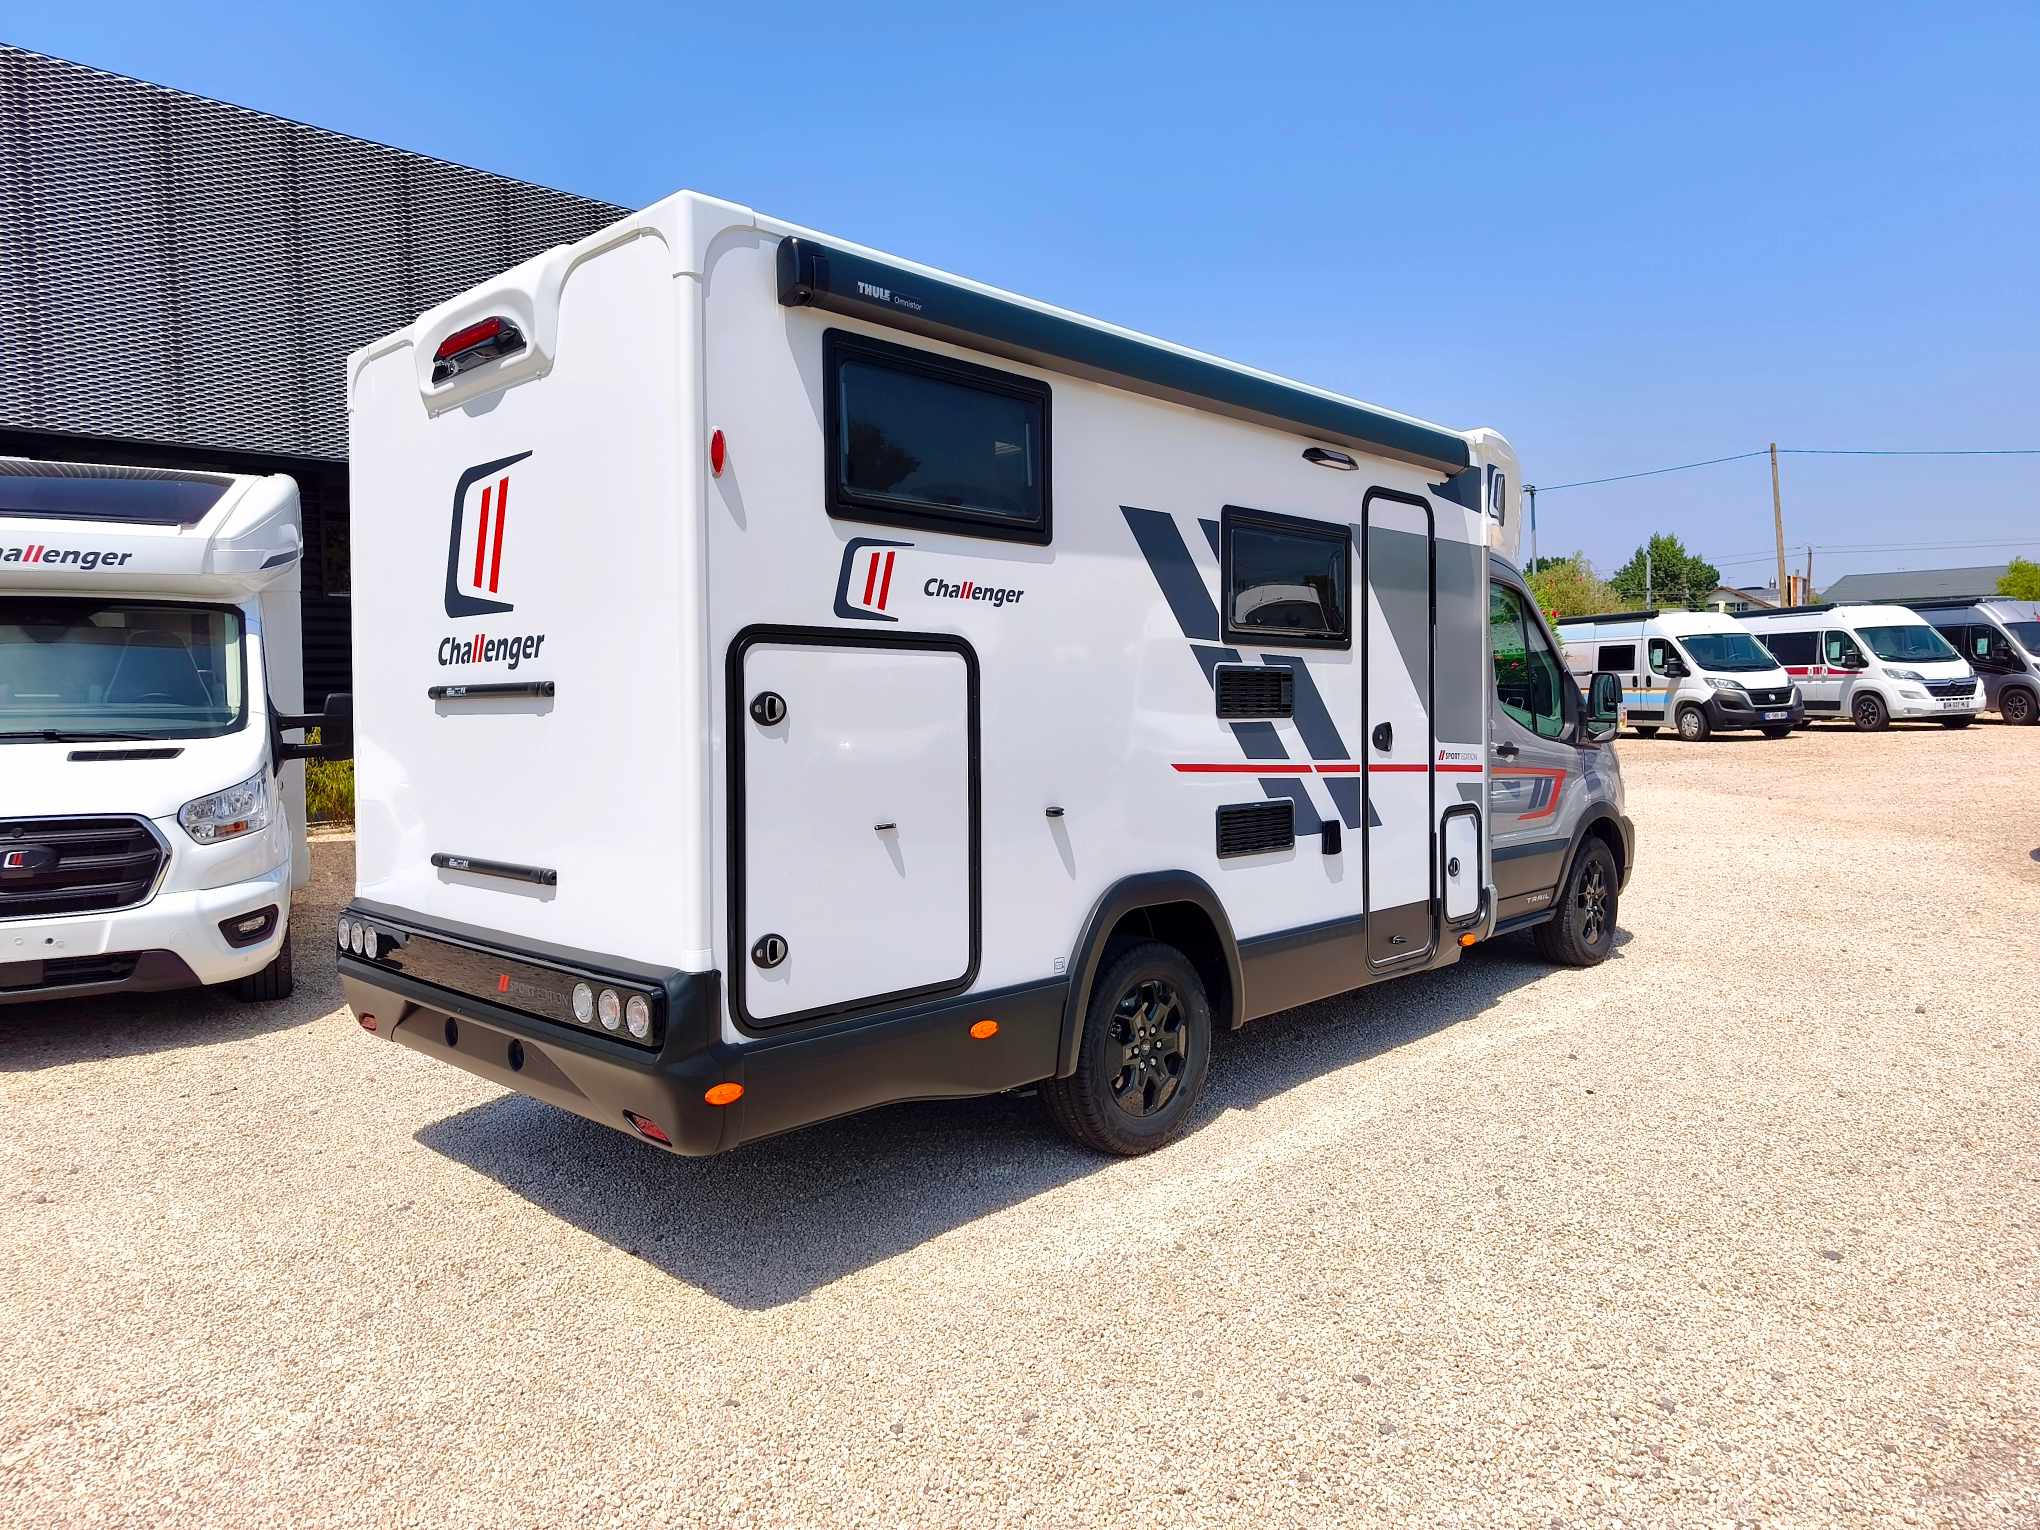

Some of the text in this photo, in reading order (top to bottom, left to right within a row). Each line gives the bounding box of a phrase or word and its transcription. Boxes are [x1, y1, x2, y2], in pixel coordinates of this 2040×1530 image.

[857, 281, 891, 302] THULE
[0, 544, 132, 570] allenger
[924, 577, 1025, 607] Challenger
[437, 633, 545, 670] Challenger
